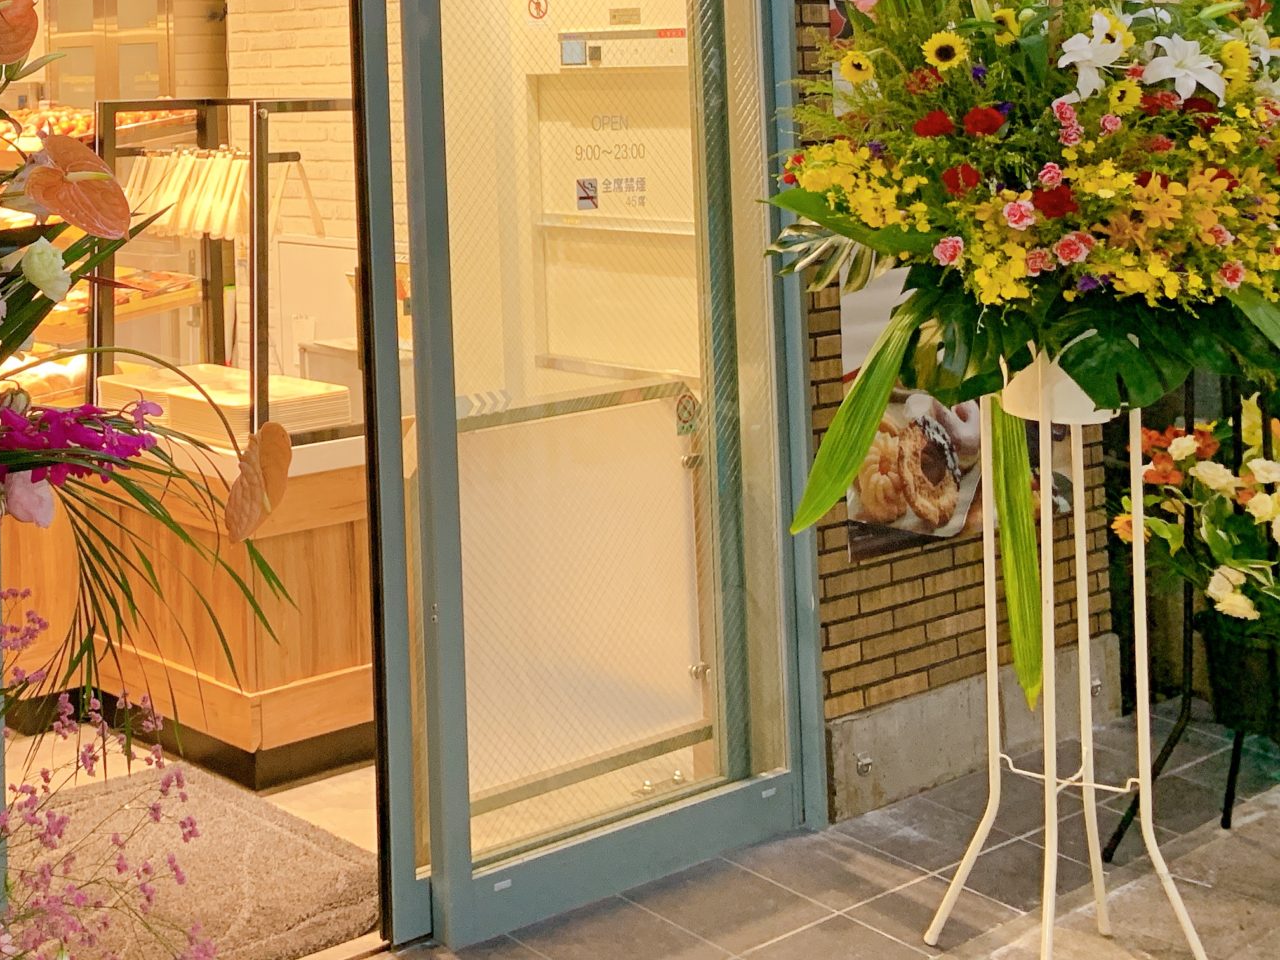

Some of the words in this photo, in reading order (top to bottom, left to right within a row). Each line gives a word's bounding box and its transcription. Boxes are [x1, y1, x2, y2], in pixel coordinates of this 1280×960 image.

[591, 115, 629, 131] OPEN
[602, 177, 646, 193] 全席禁煙
